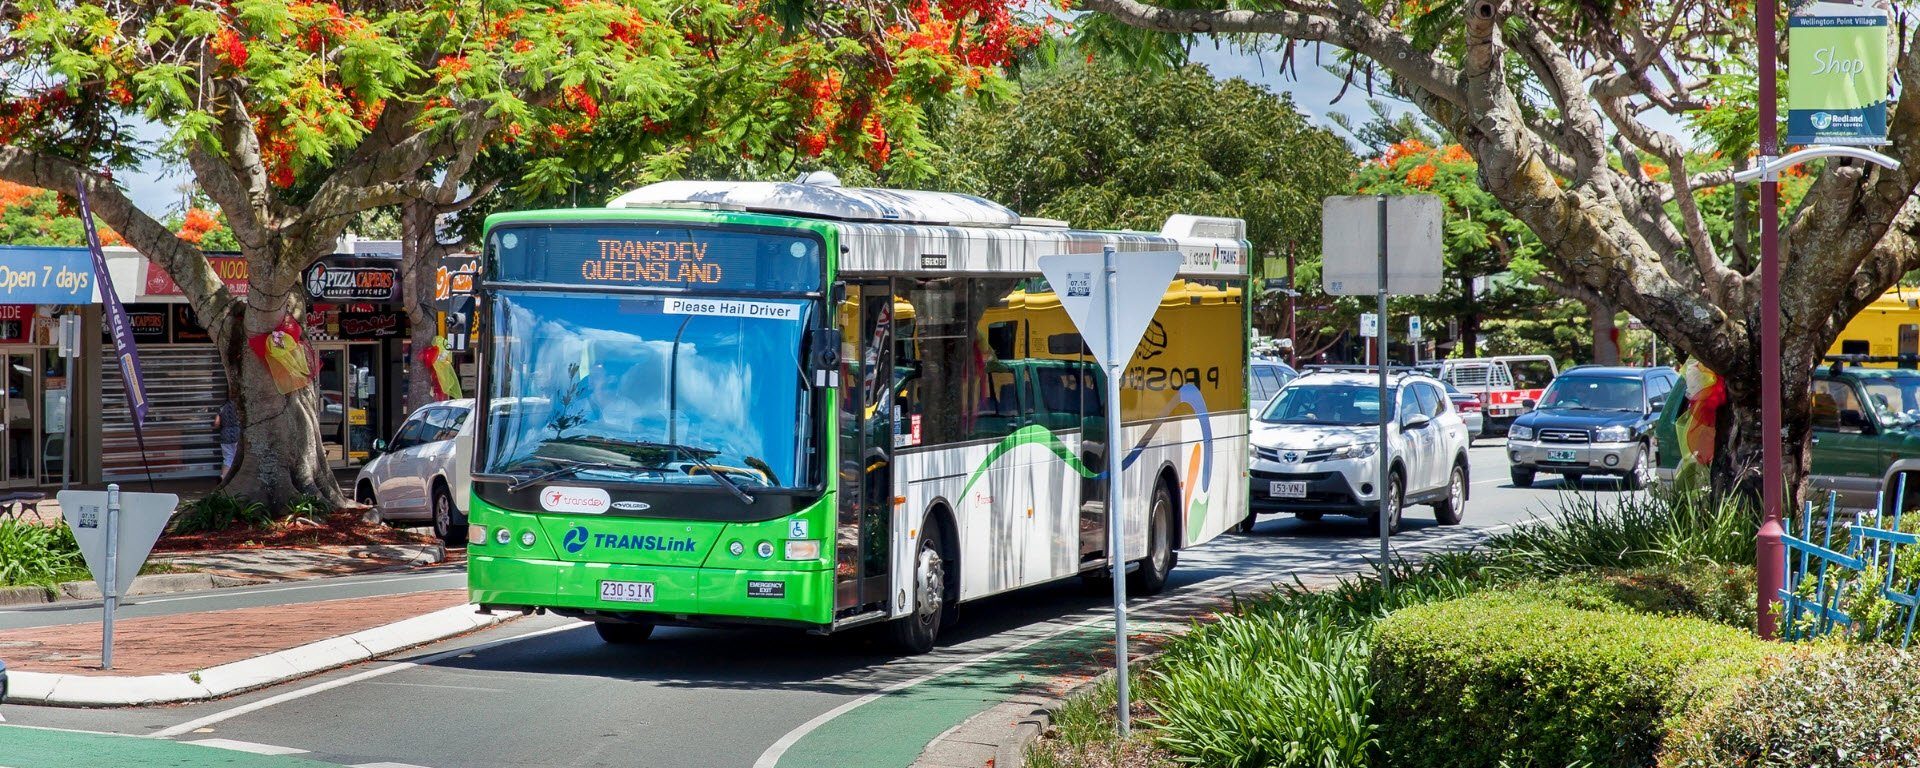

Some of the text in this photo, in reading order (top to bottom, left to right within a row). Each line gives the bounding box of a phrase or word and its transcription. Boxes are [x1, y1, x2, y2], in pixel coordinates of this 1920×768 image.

[1800, 18, 1834, 26] Wellington
[1855, 17, 1877, 26] Village
[1811, 45, 1864, 86] Shop
[598, 239, 708, 262] TRANSDEV
[0, 265, 89, 295] Open 7 days
[582, 260, 722, 283] QUEENSLAND
[672, 301, 791, 317] Please Hail Driver
[564, 497, 605, 507] transdev
[594, 533, 697, 553] TRANSLink
